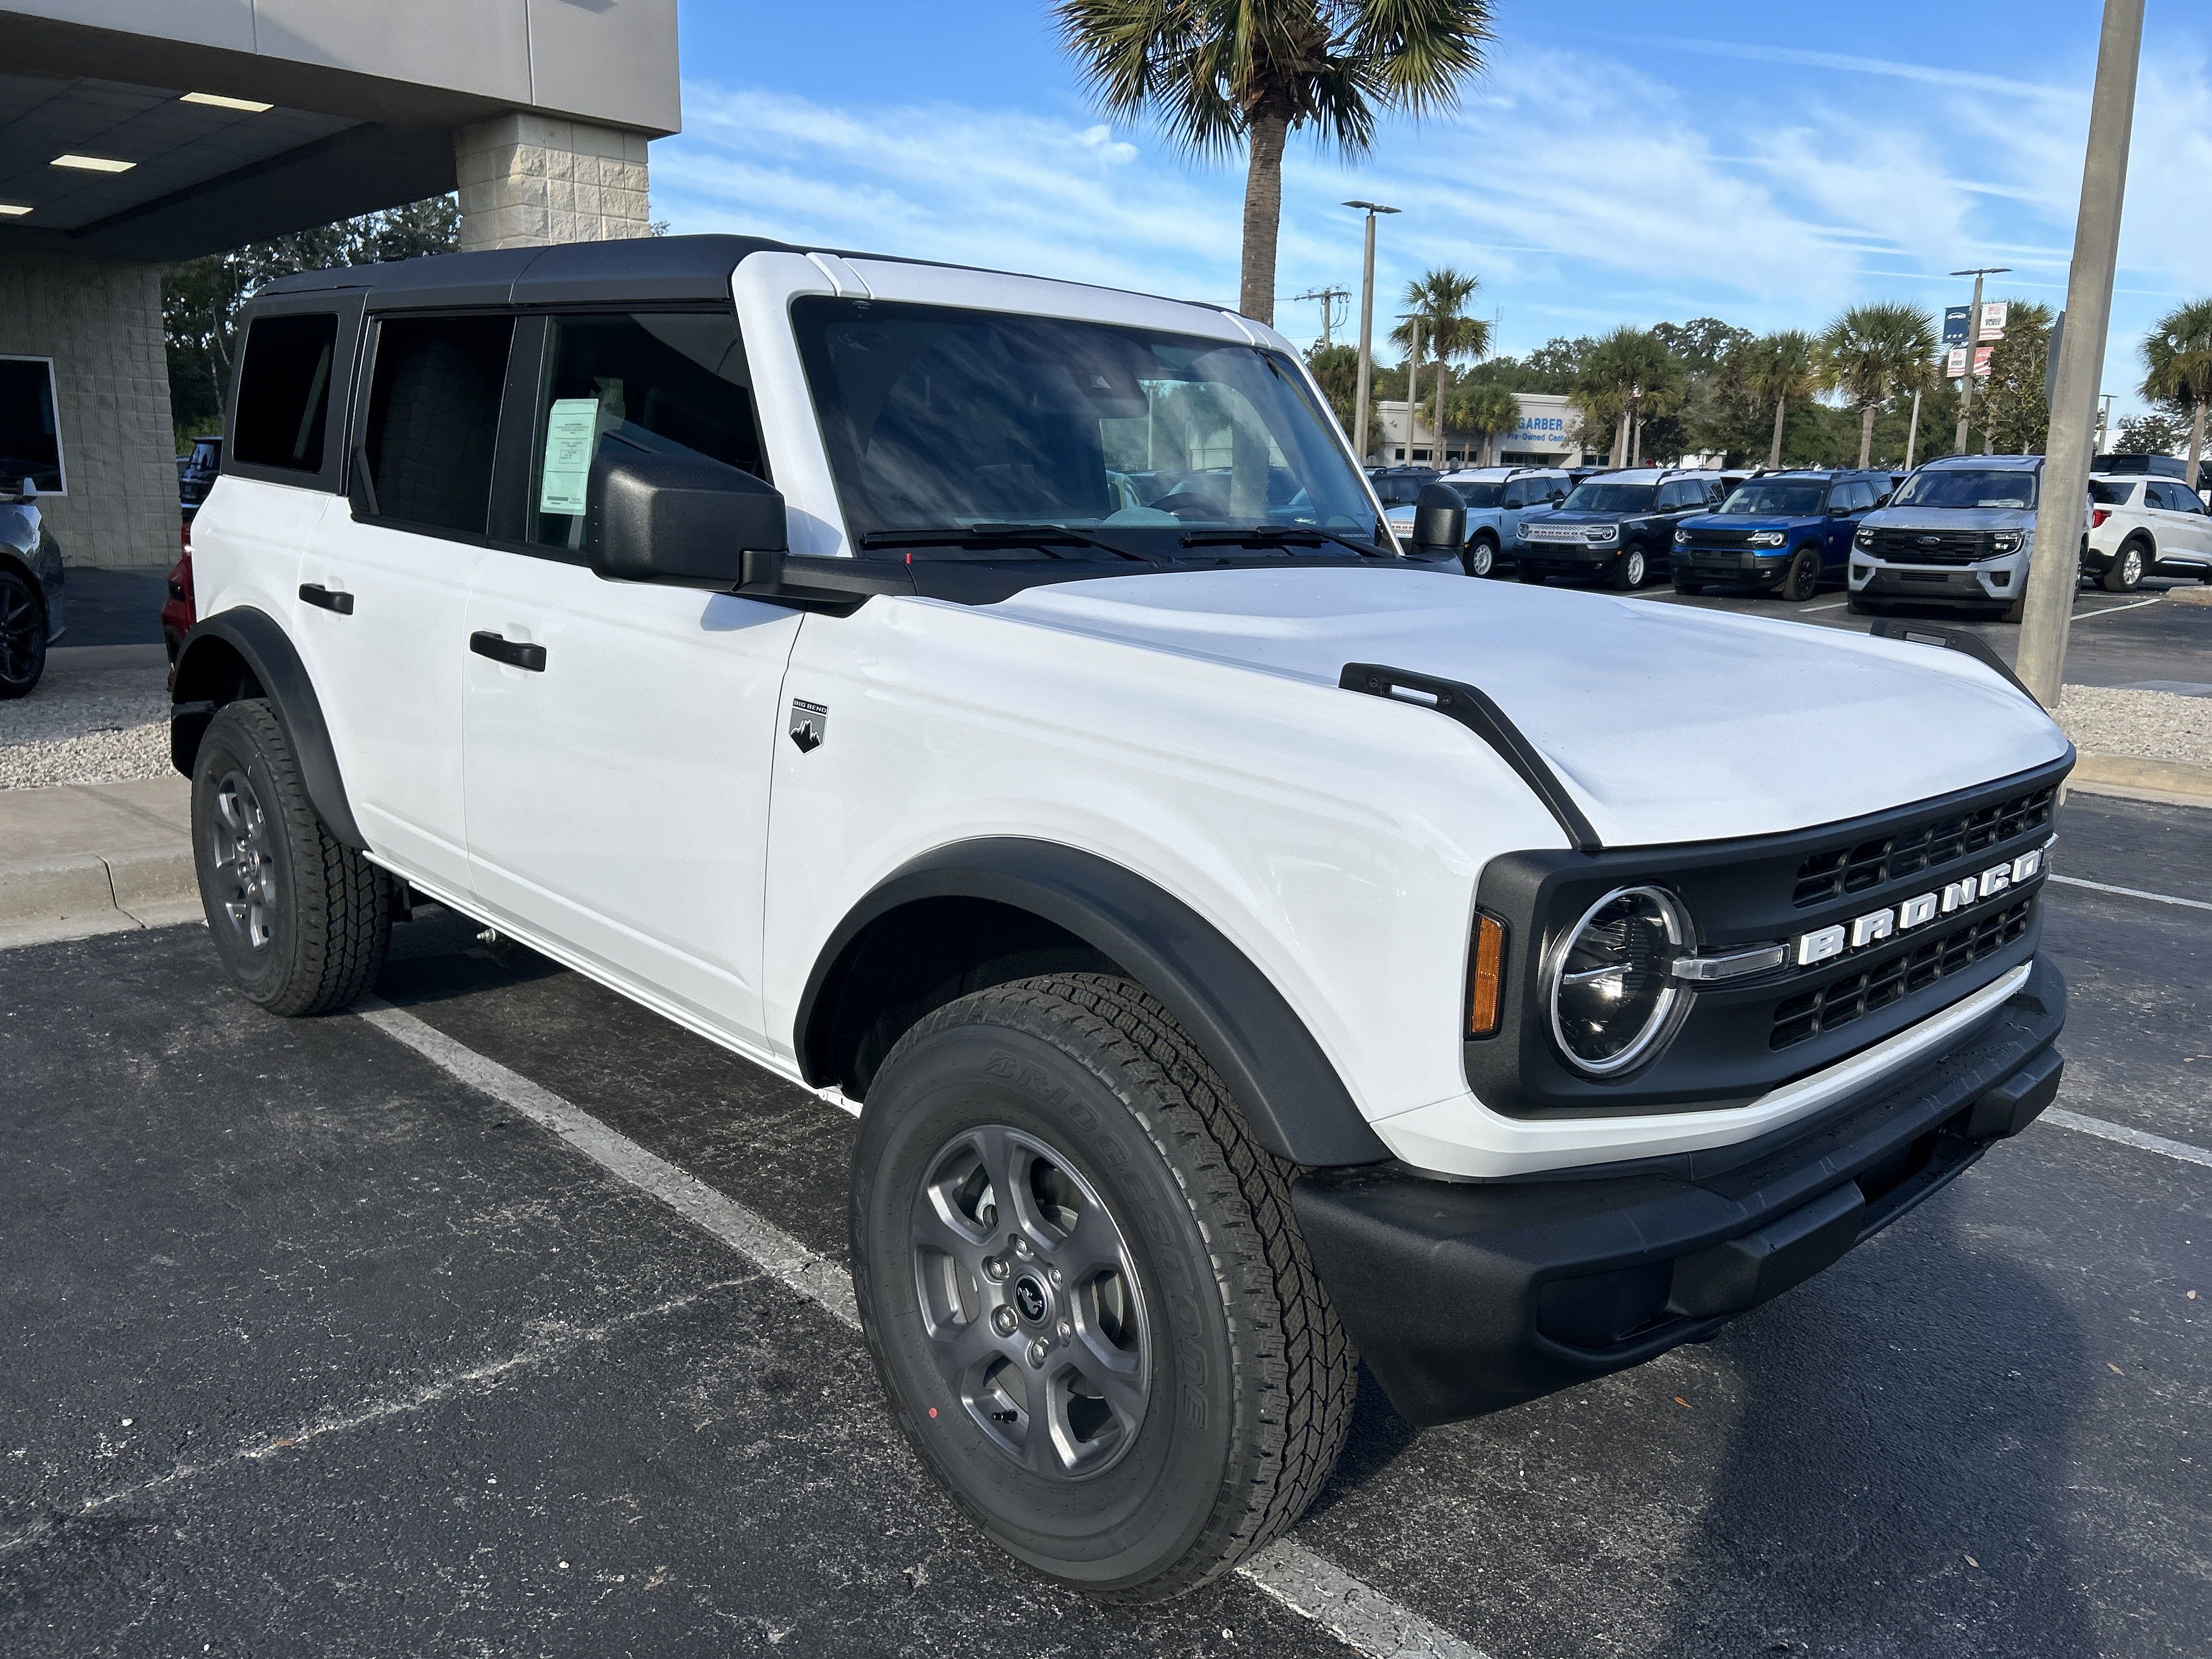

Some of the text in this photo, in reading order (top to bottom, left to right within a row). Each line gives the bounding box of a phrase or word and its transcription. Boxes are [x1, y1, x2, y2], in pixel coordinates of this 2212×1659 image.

[1518, 417, 1563, 431] GARBER
[794, 700, 827, 713] BIG BEND
[1798, 850, 2040, 966] BRONCO
[983, 1048, 1208, 1431] BRIDGESTONE
